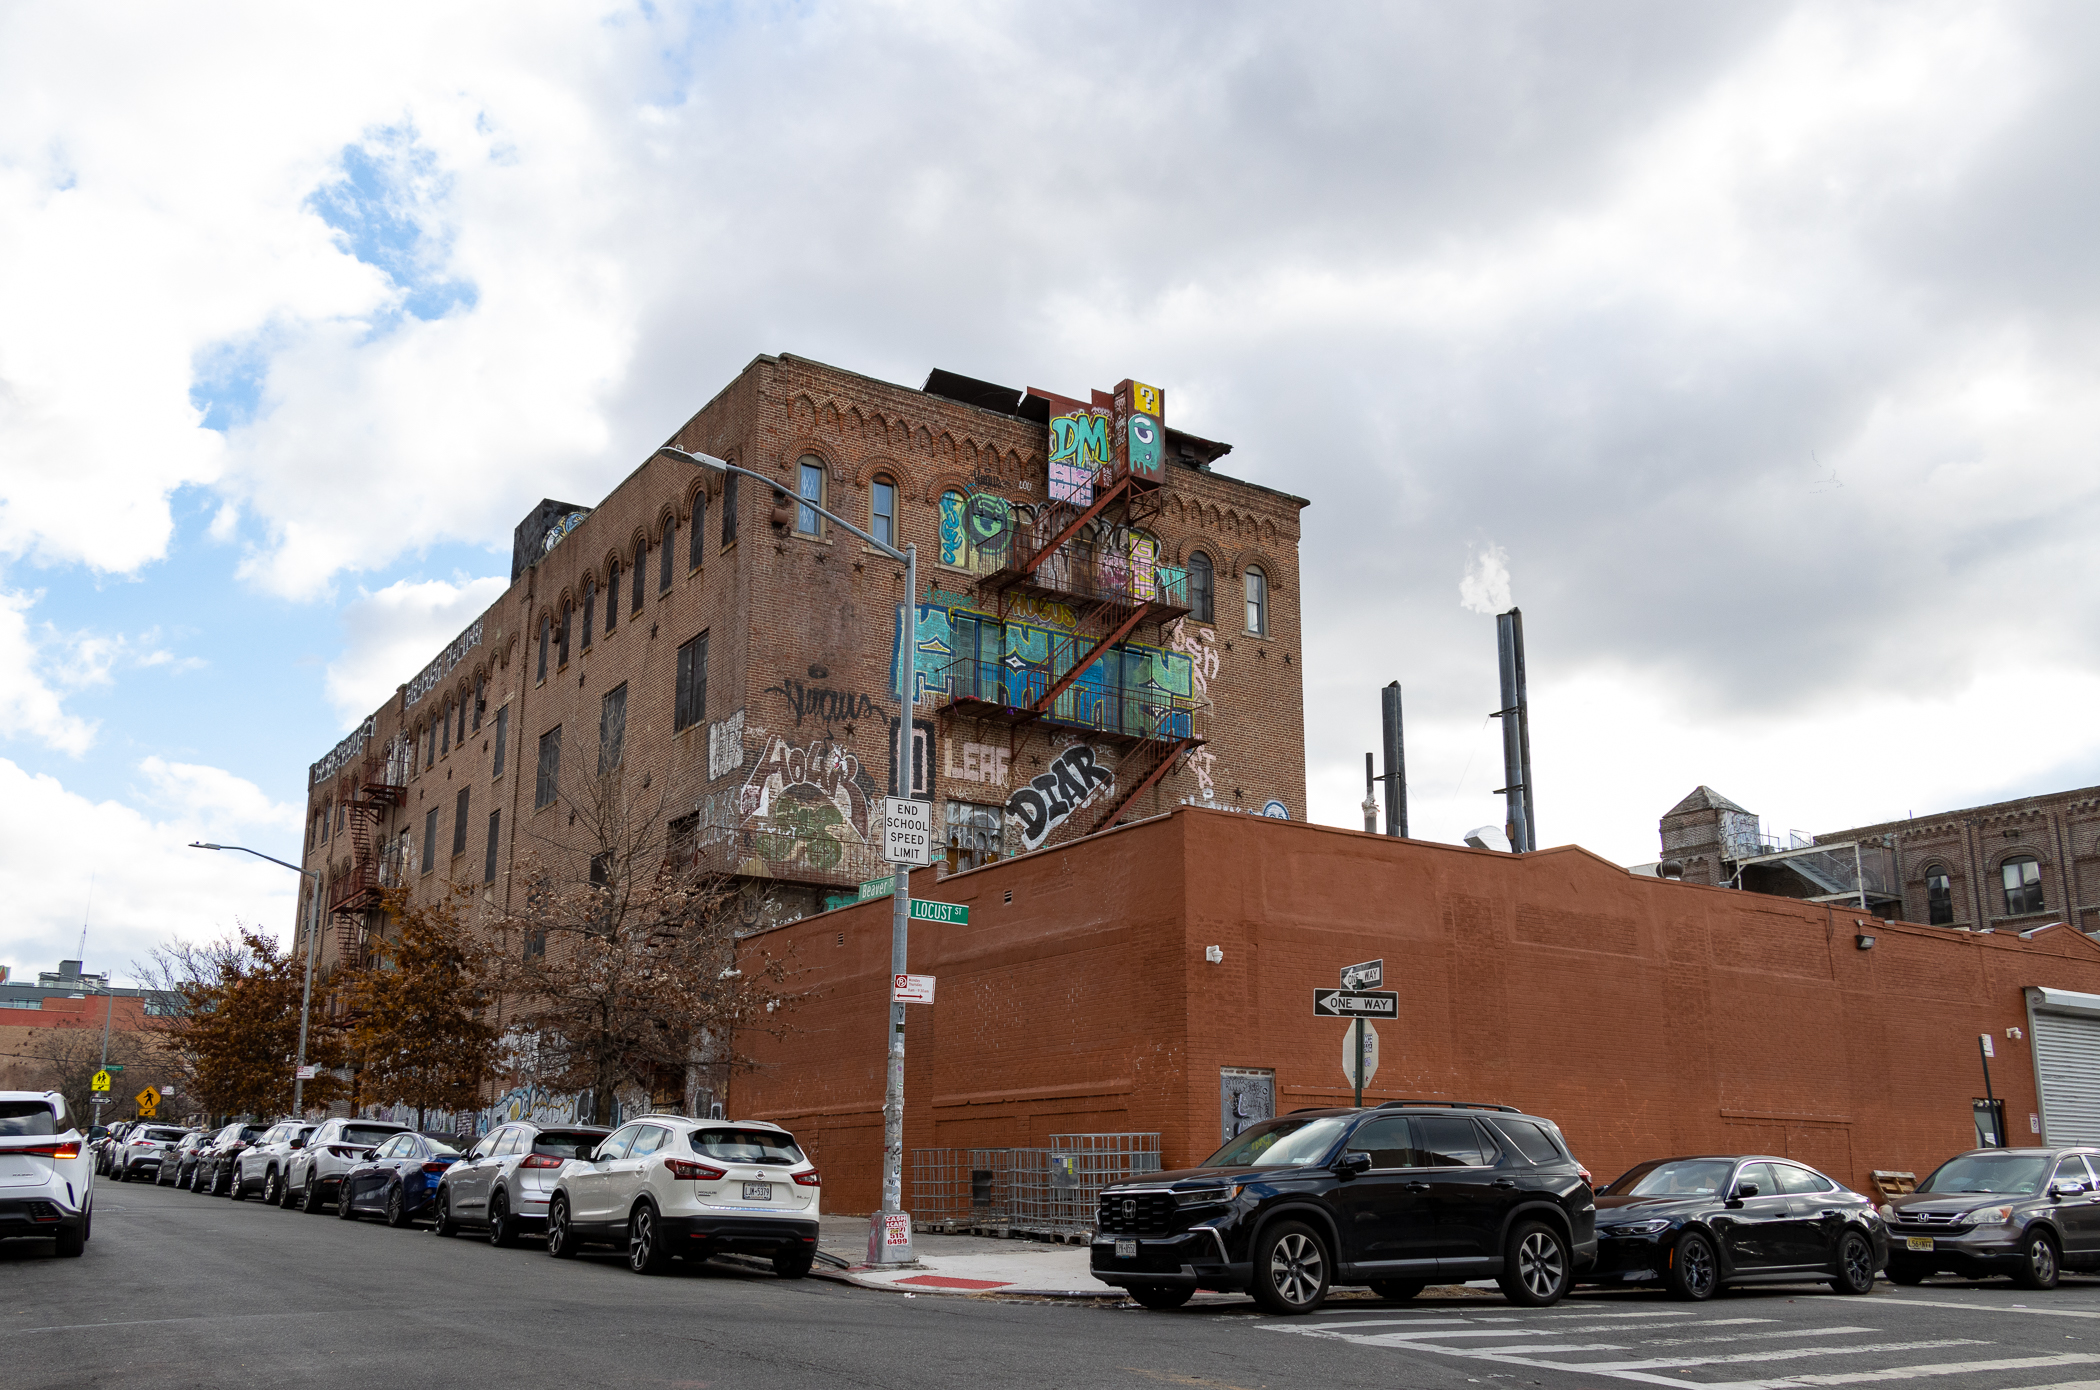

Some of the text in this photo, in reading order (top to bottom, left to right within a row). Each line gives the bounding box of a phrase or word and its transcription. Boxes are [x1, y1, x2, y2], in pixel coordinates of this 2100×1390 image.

[1019, 480, 1032, 491] LOU
[1005, 744, 1115, 848] DIAR
[897, 804, 918, 816] END
[887, 817, 928, 832] SCHOOL
[890, 832, 924, 845] SPEED
[894, 847, 919, 859] LIMIT
[862, 880, 887, 898] Beaver
[915, 901, 963, 920] LOCUST ST
[1365, 969, 1378, 981] WAY
[1330, 997, 1388, 1010] ONE WAY
